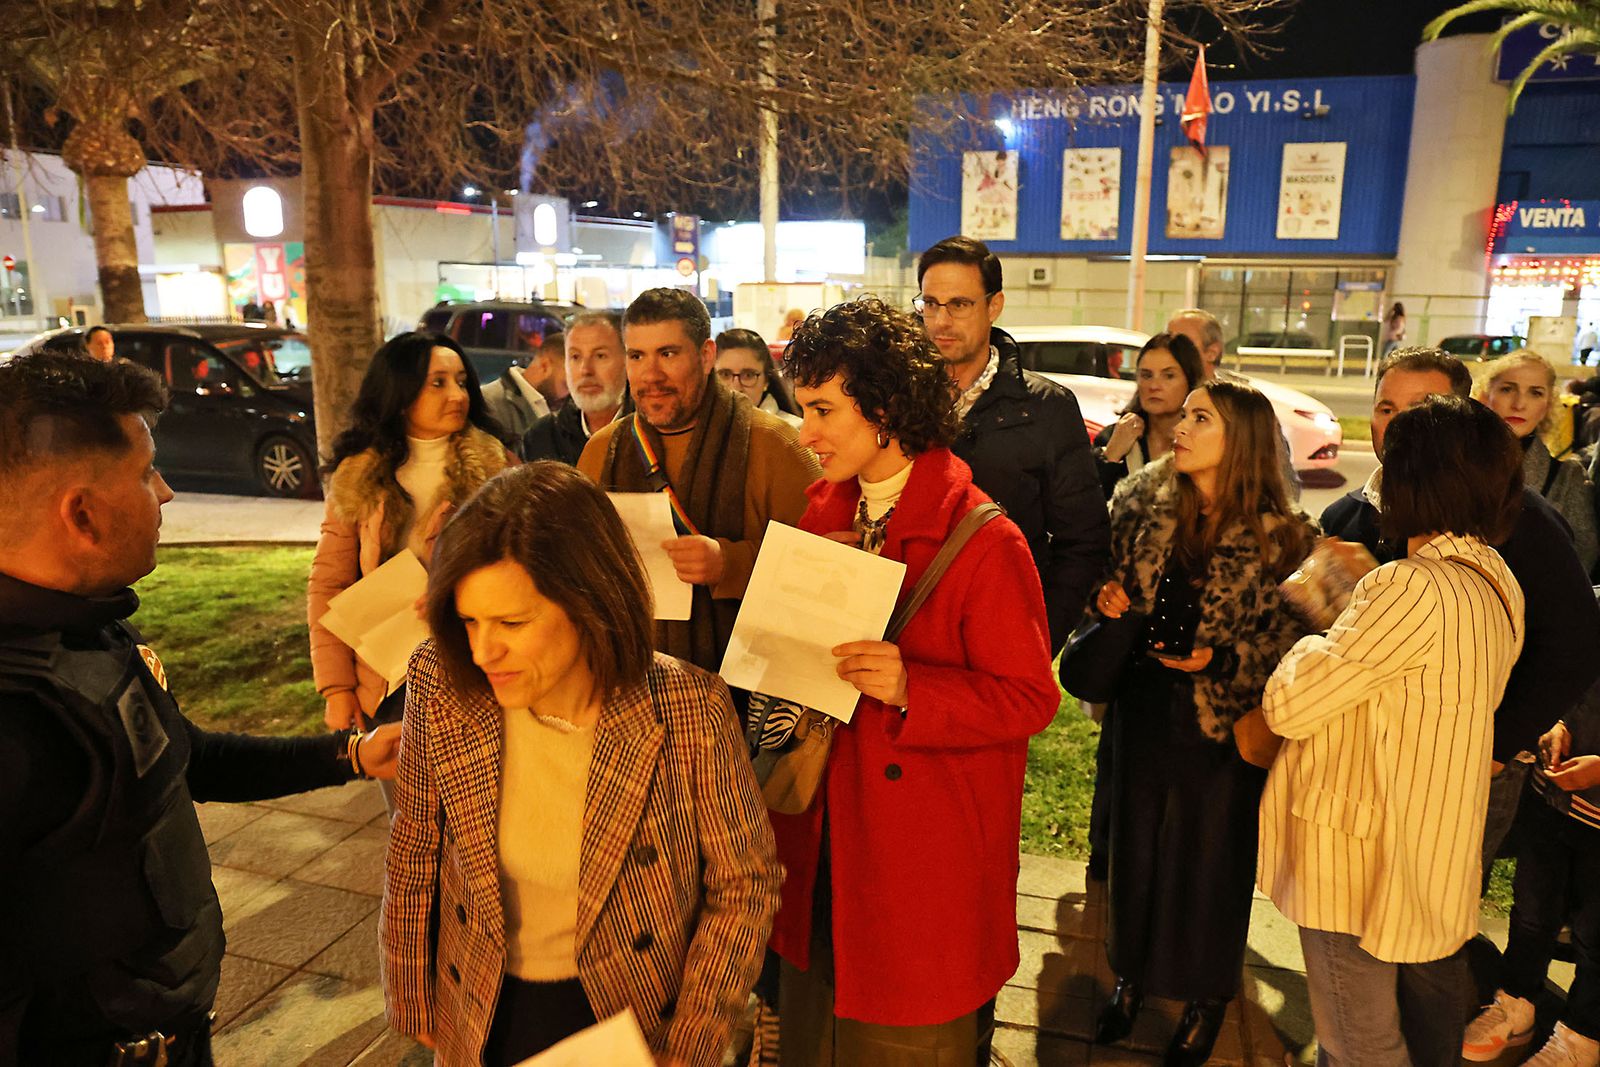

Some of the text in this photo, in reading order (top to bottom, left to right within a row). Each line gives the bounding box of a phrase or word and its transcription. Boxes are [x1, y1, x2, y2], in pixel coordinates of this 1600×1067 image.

[1174, 92, 1235, 115] MO
[1286, 174, 1336, 184] MASCOTAS
[1519, 207, 1585, 228] VENTA
